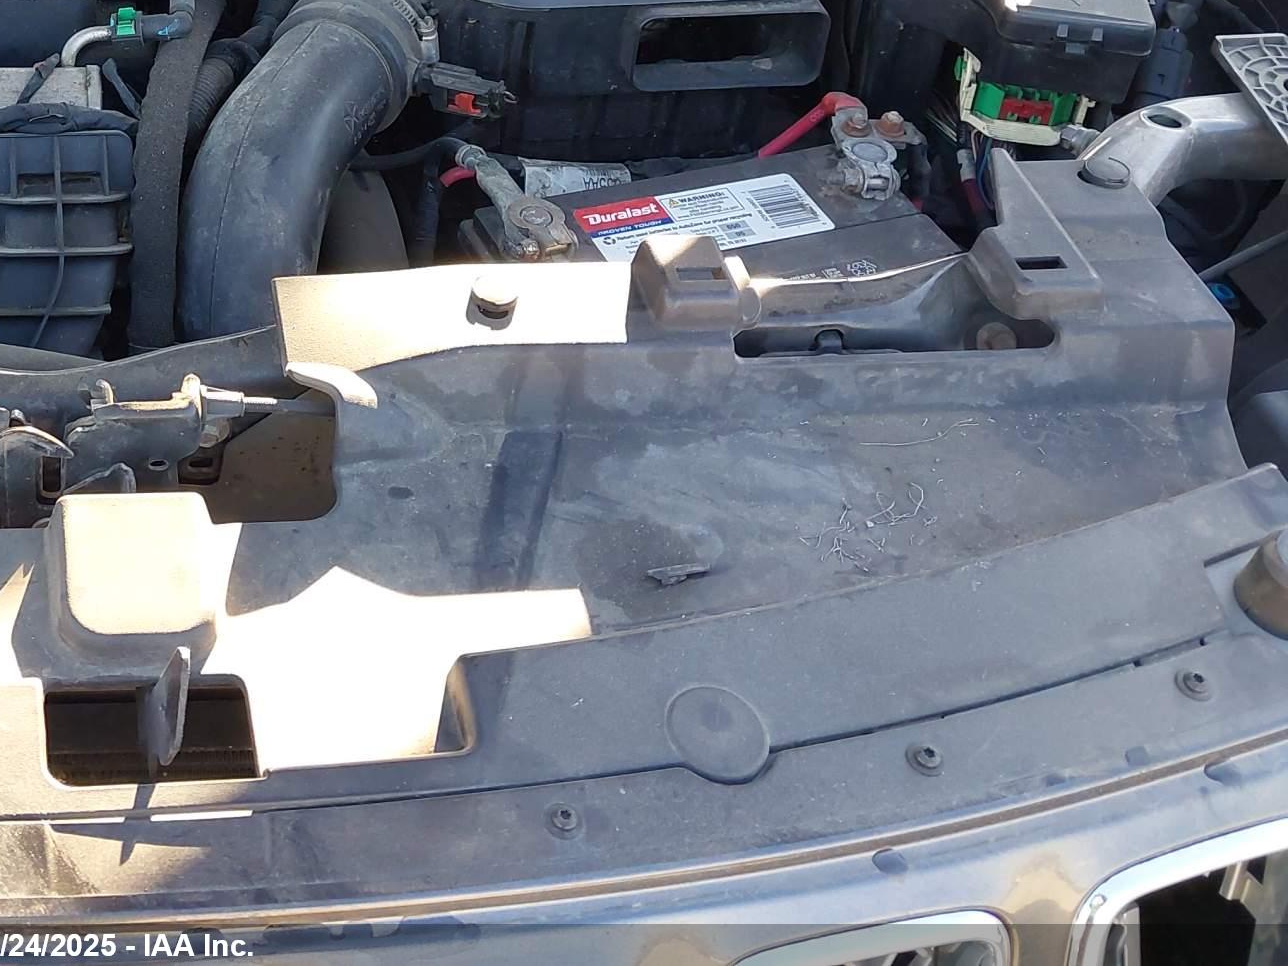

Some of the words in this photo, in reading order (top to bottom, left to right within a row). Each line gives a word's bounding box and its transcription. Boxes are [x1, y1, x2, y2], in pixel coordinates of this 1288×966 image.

[582, 203, 659, 225] Duralast
[598, 225, 632, 236] PROVEN
[634, 220, 662, 229] TOUGH
